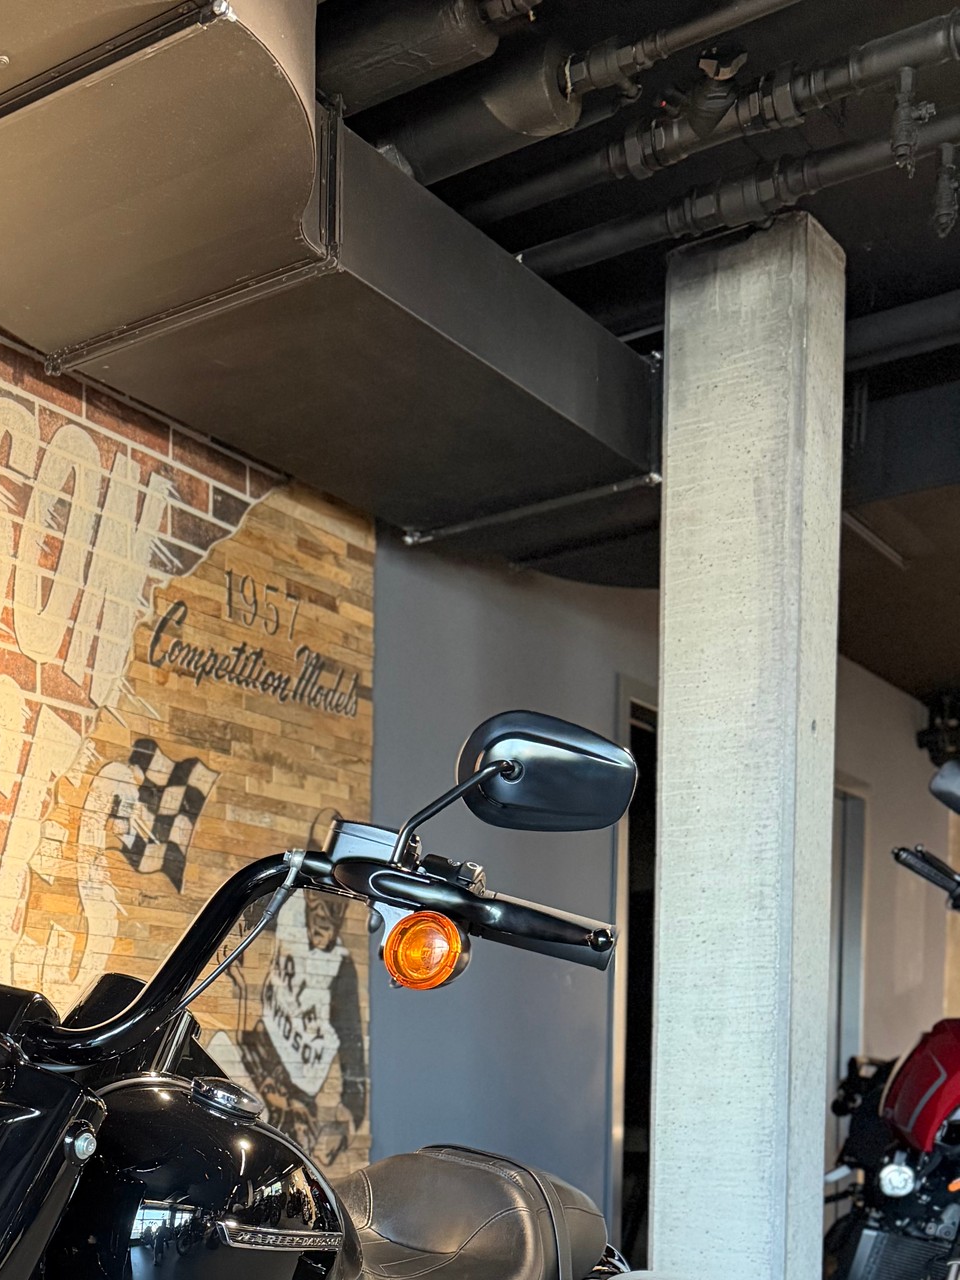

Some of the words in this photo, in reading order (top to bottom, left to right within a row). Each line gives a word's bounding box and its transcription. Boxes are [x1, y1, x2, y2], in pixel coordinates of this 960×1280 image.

[224, 568, 302, 640] 1957
[147, 600, 290, 703] Competition
[294, 644, 360, 718] Models
[273, 944, 325, 1043] ARLEY
